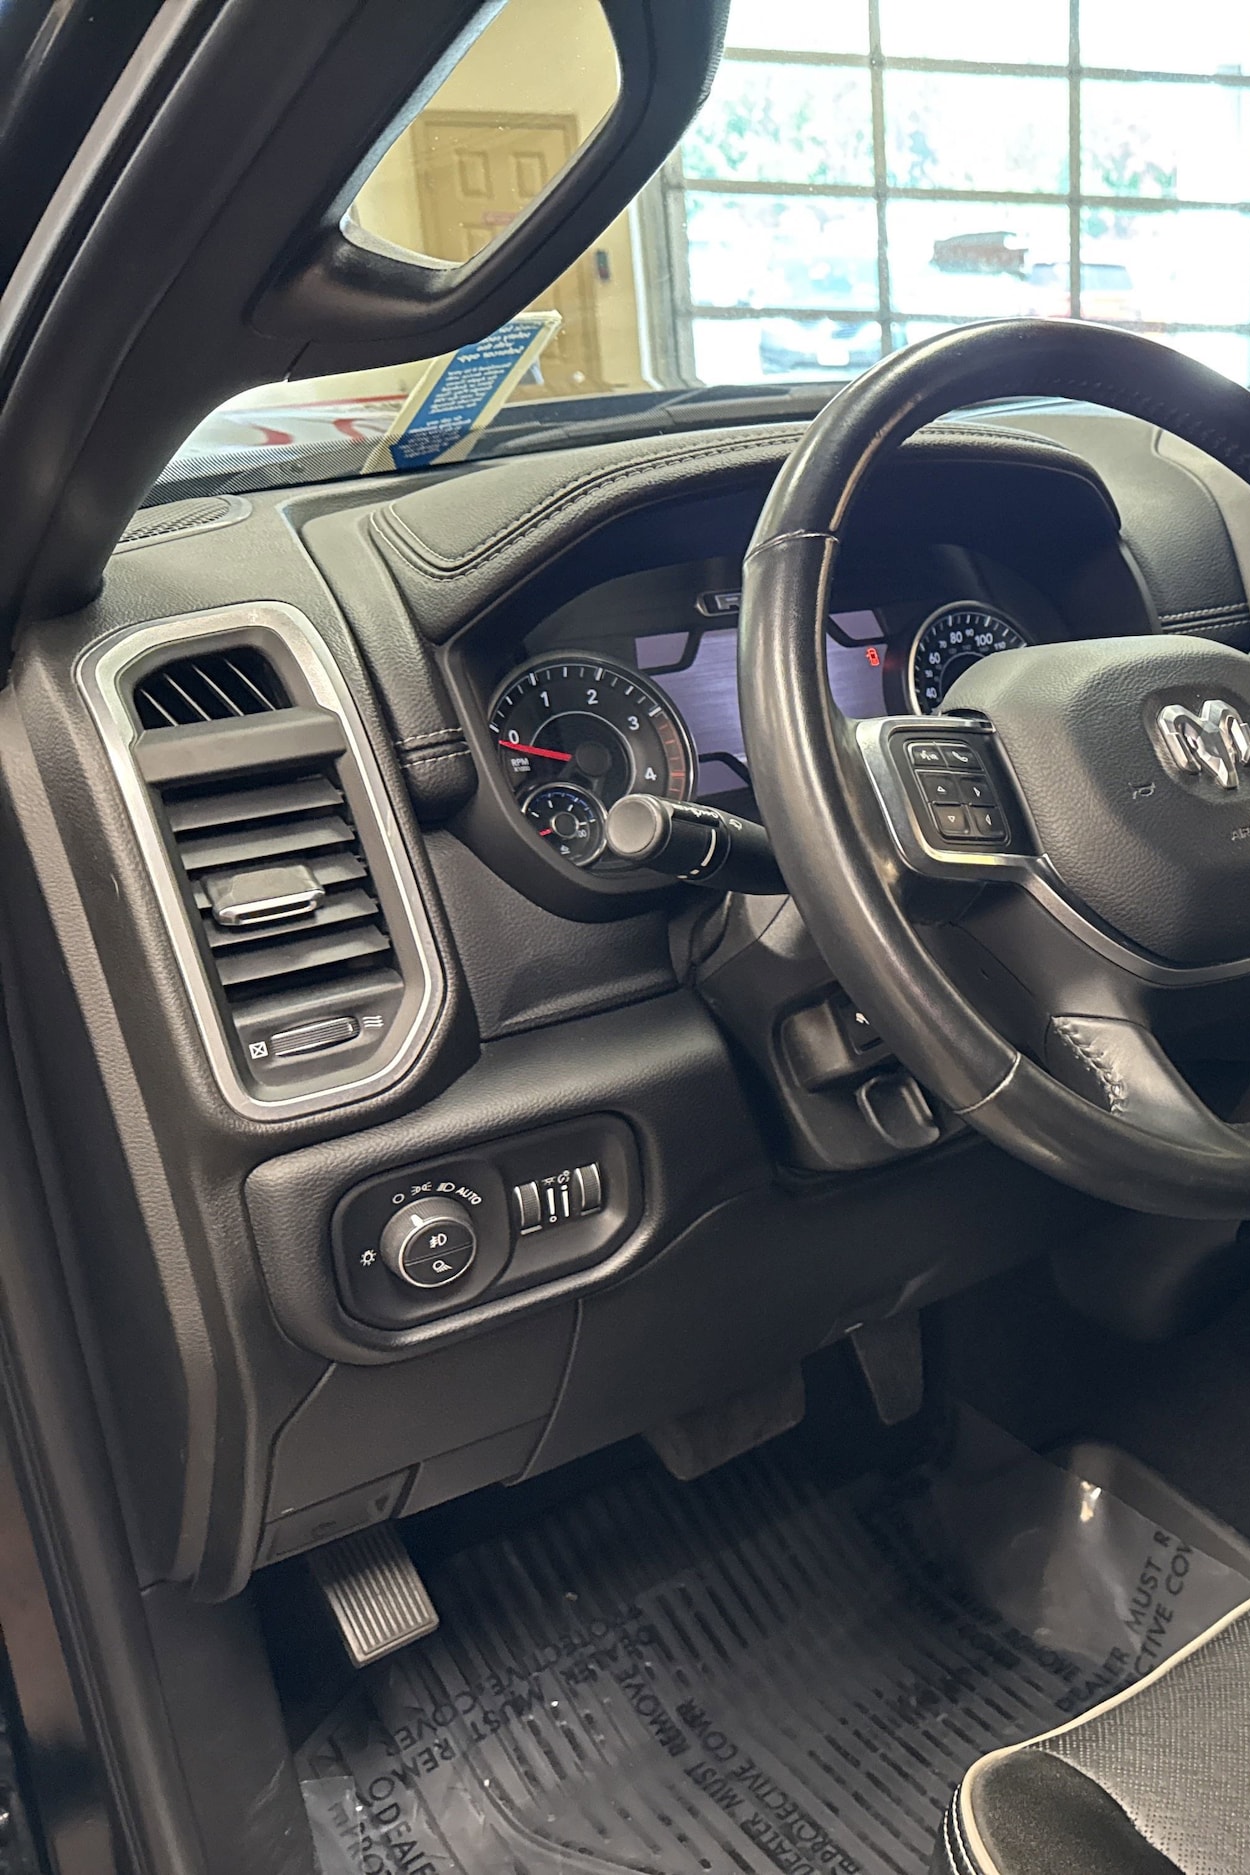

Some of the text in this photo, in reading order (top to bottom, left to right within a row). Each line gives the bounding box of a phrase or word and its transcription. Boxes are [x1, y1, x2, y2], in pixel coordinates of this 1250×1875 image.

[949, 631, 963, 645] 80
[965, 628, 975, 638] 90
[974, 632, 993, 647] 100
[928, 652, 941, 665] 60
[540, 690, 550, 707] 1
[587, 688, 599, 706] 2
[925, 687, 938, 699] 40
[627, 714, 640, 731] 3
[508, 729, 520, 745] 0
[510, 757, 530, 768] RPM
[643, 765, 657, 782] 4
[455, 1186, 482, 1205] AUTO
[1124, 1556, 1163, 1633] MUST
[470, 1674, 546, 1743] MUST
[617, 1664, 691, 1759] REMOVE
[683, 1760, 745, 1811] MUST
[374, 1801, 439, 1875] DEALE
